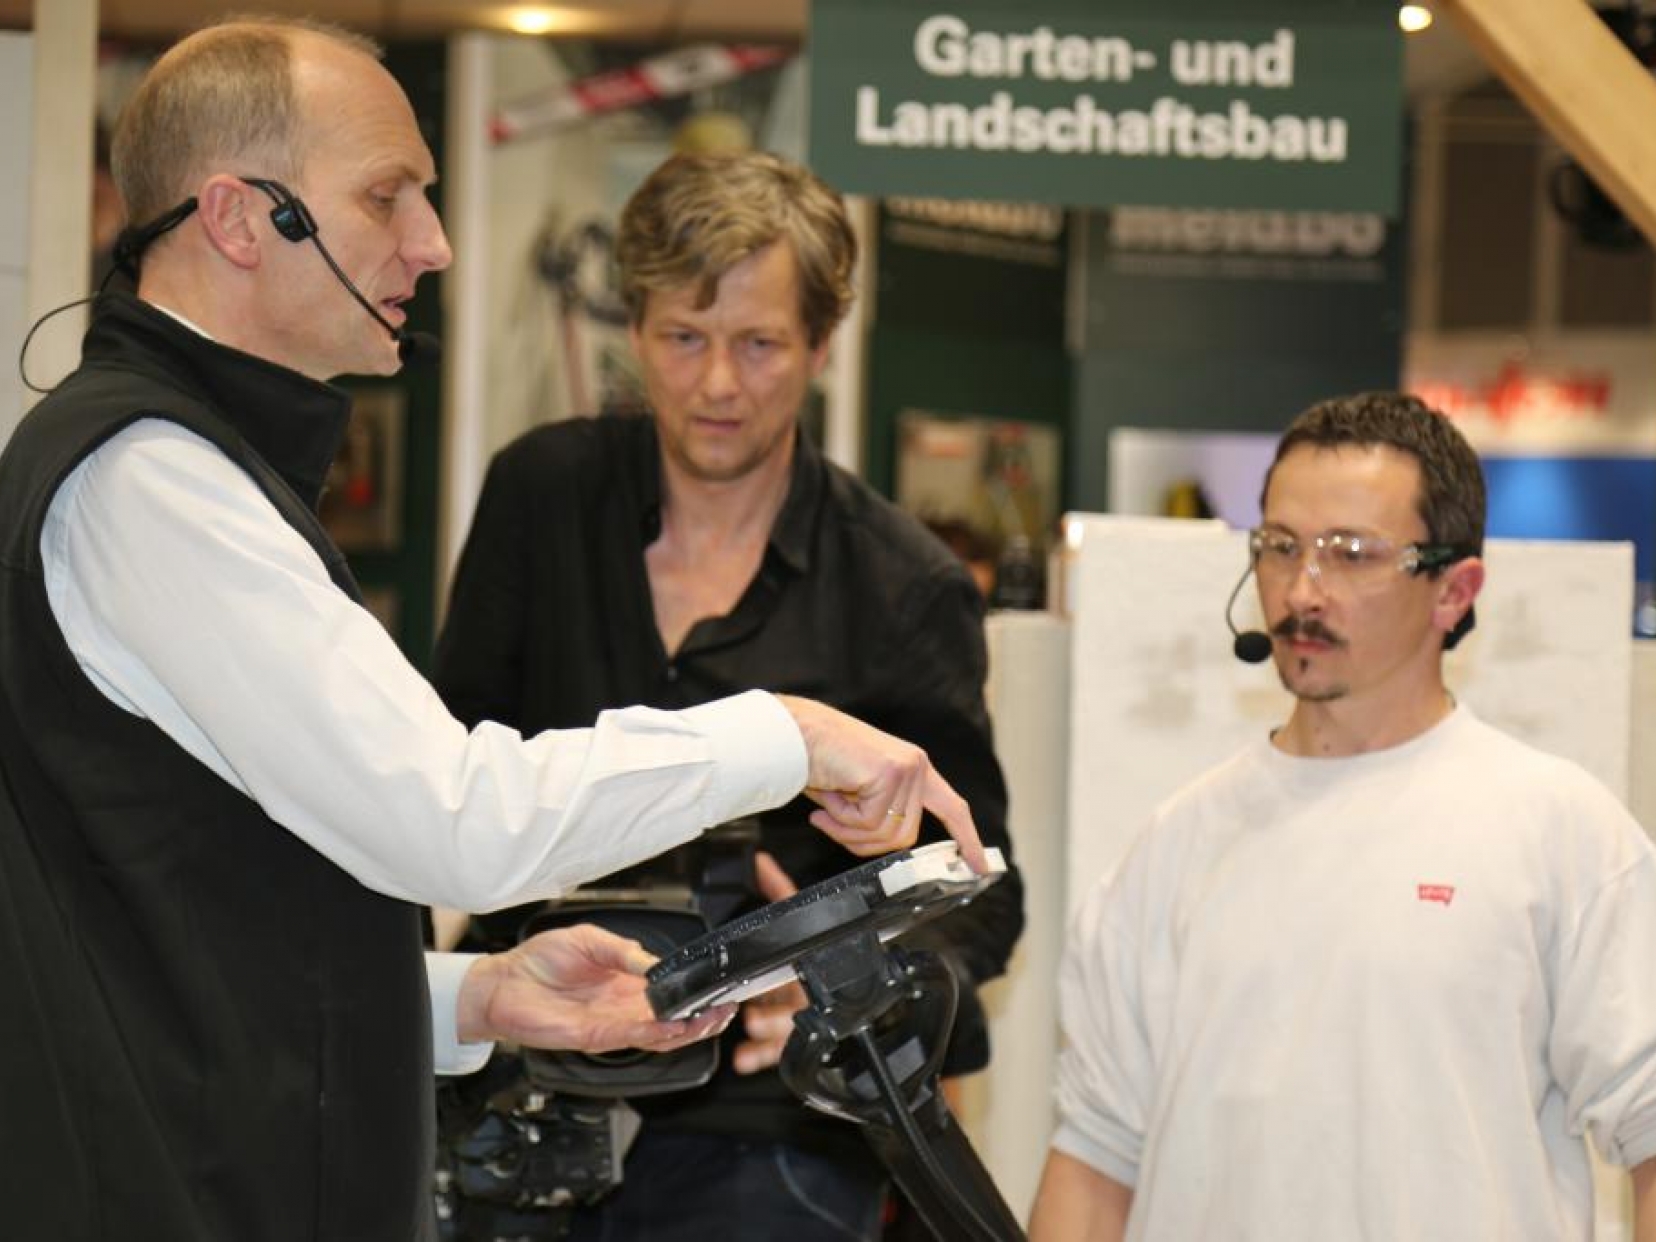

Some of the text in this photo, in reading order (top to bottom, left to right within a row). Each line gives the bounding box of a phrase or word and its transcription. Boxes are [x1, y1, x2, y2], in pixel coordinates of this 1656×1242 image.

[914, 15, 1295, 87] Garten- und
[855, 86, 1348, 161] Landschaftsbau
